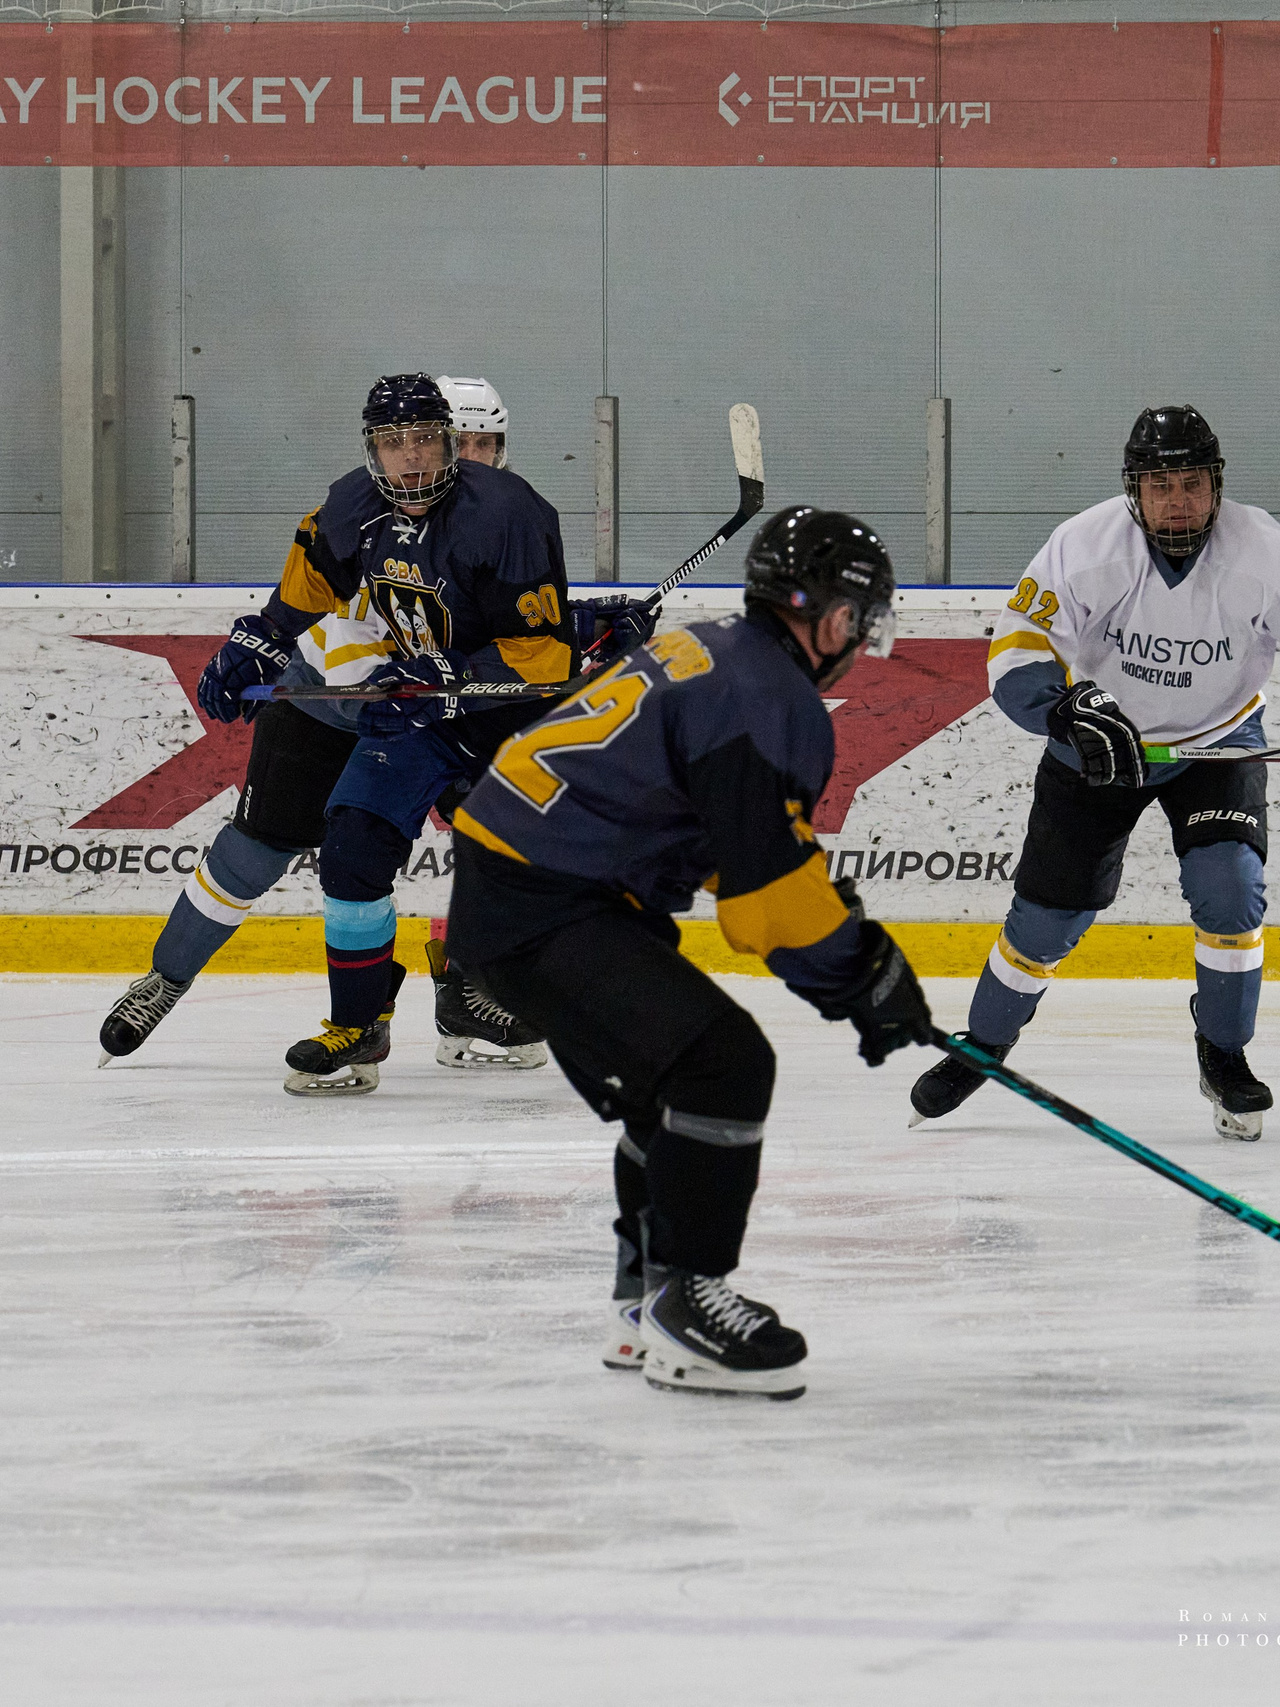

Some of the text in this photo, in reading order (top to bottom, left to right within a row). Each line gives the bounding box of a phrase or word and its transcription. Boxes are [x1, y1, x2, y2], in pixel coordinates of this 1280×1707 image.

[65, 75, 332, 125] HOCKEY
[352, 75, 607, 124] LEAGUE
[767, 75, 926, 99] СПОРТ
[767, 100, 991, 129] СТАНЦИЯ
[661, 539, 721, 595] WARRIOR
[516, 584, 561, 627] 90
[1006, 577, 1060, 631] 82
[460, 682, 531, 695] BAUER
[1121, 660, 1193, 689] HOCKEY CLUB
[1186, 809, 1260, 828] BAUER
[826, 850, 1019, 881] ПИРОВК
